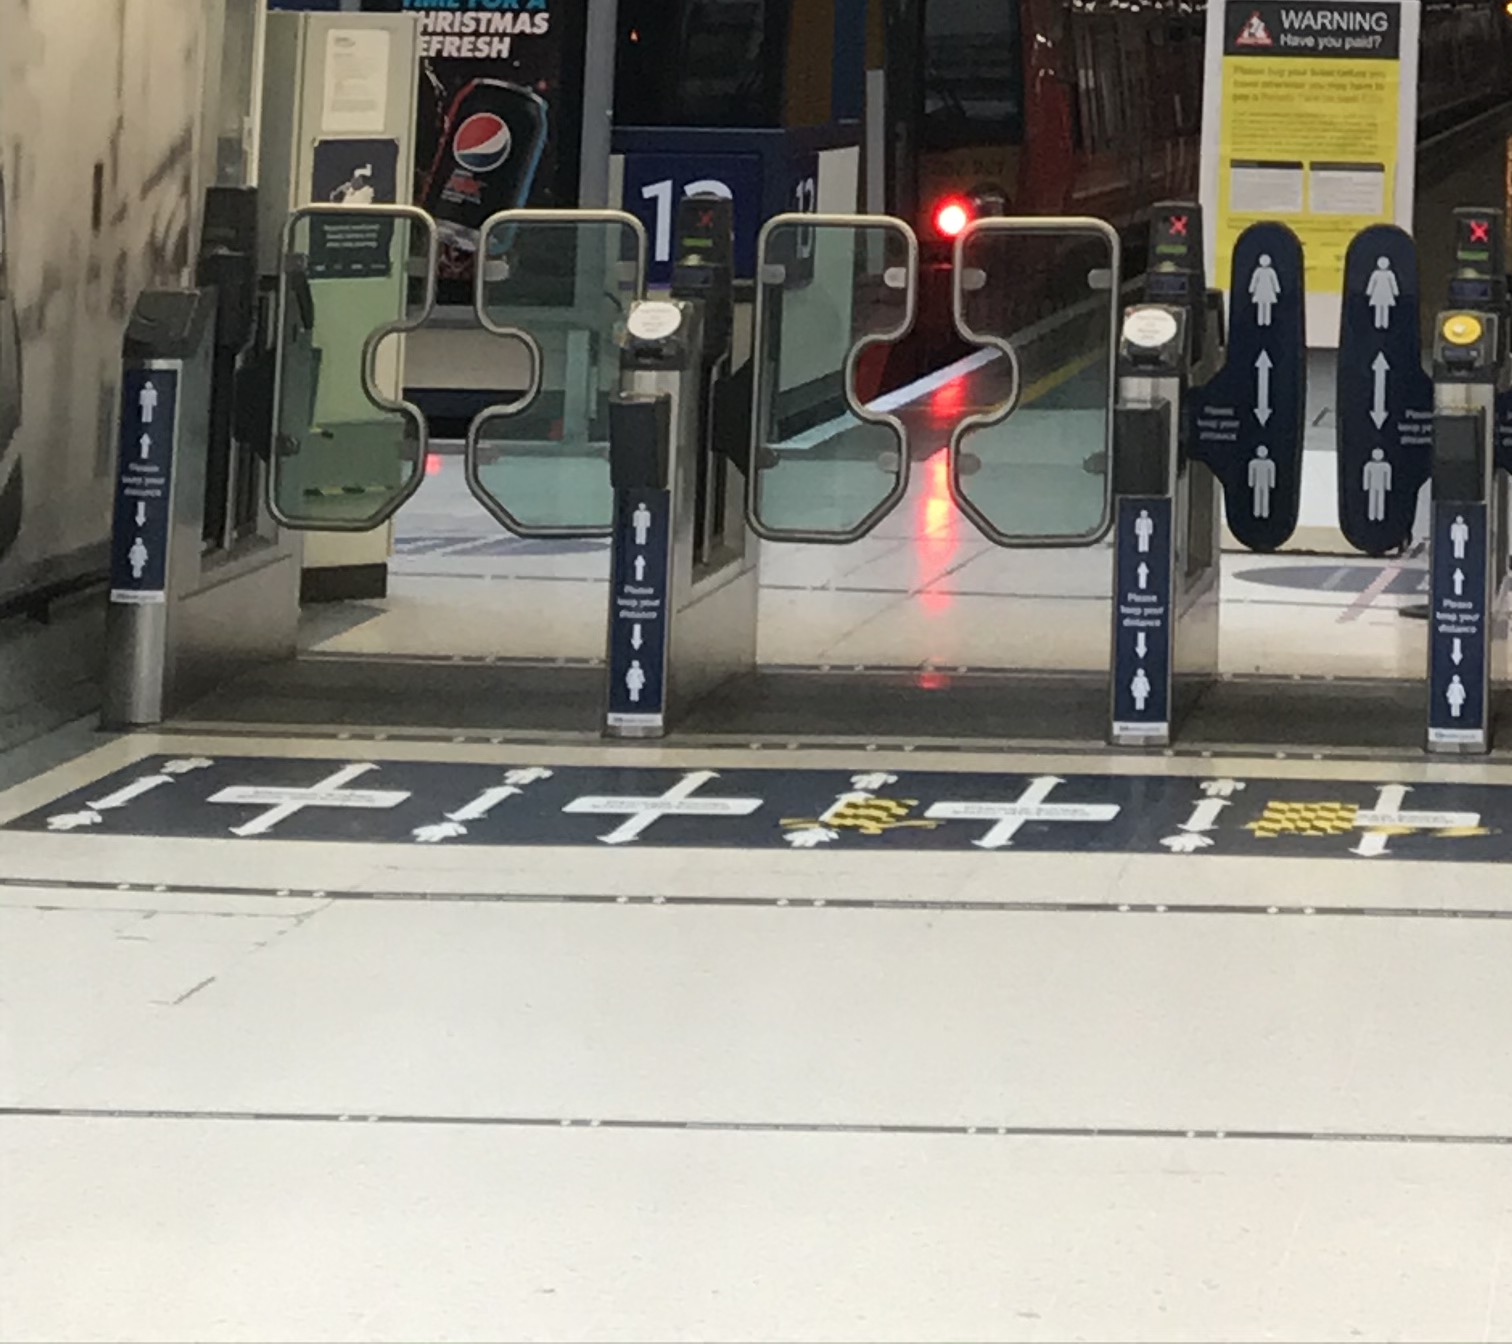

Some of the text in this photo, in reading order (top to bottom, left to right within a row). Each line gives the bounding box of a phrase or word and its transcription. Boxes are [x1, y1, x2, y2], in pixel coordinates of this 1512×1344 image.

[419, 11, 550, 34] HRISTMAS
[1280, 10, 1388, 31] WARNING
[420, 36, 511, 58] EFRESH
[1280, 34, 1382, 50] Have you paid?
